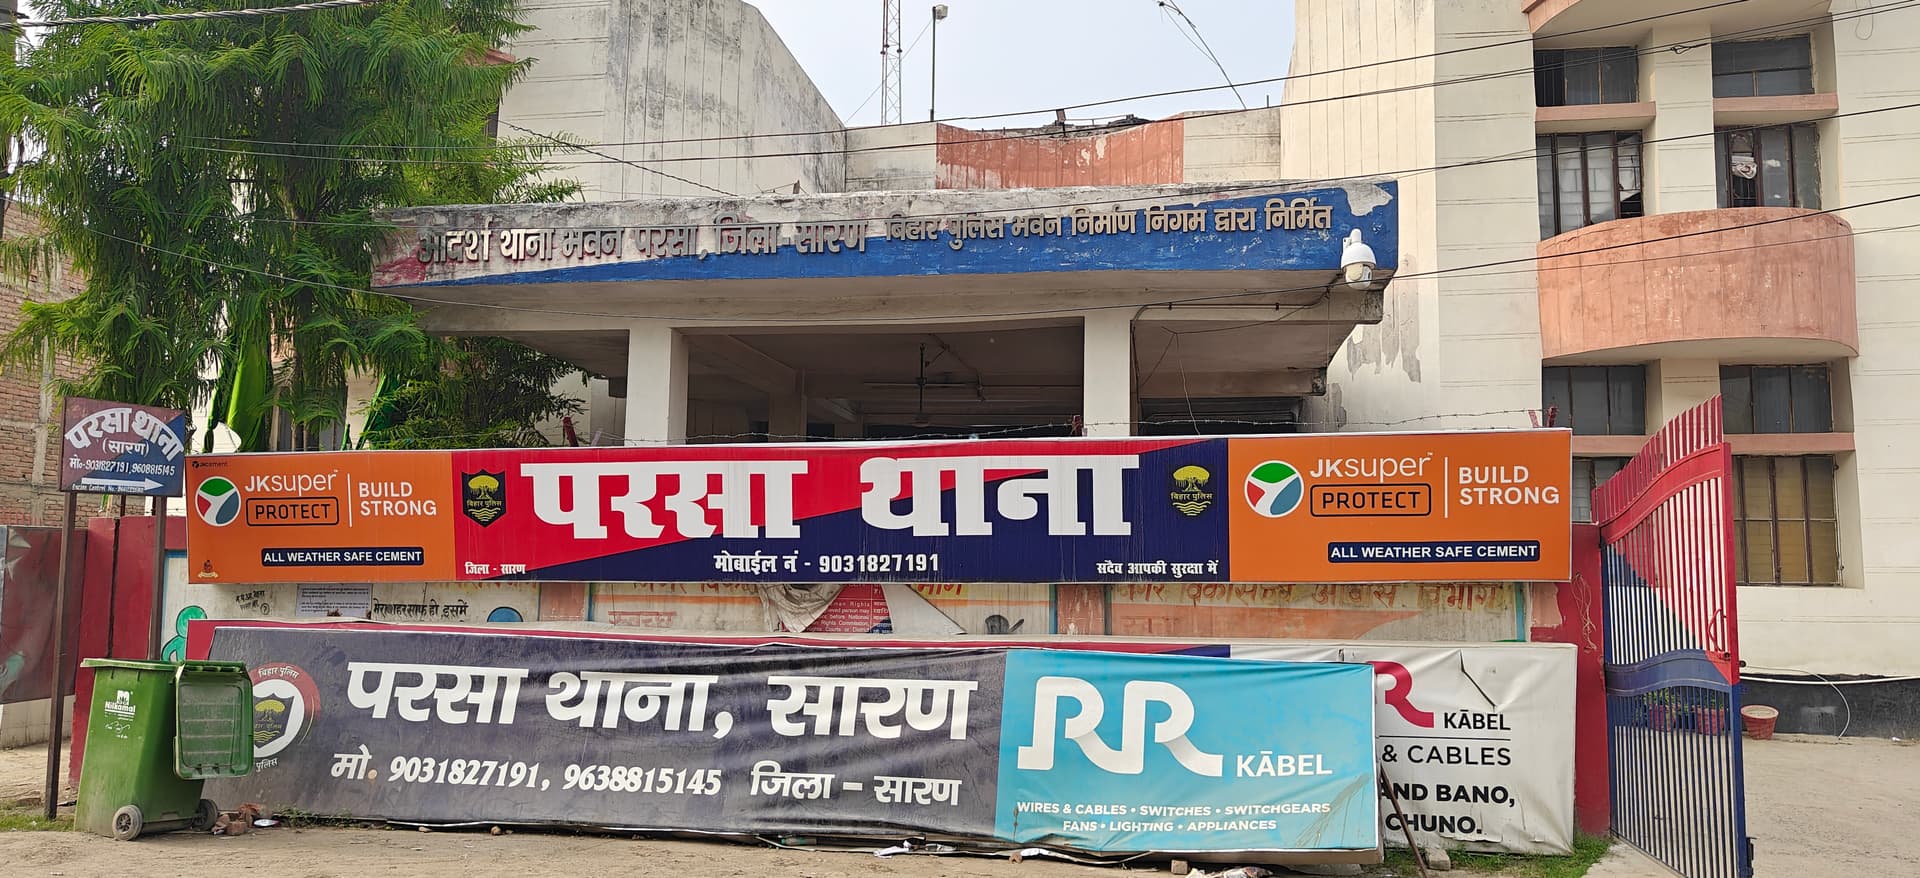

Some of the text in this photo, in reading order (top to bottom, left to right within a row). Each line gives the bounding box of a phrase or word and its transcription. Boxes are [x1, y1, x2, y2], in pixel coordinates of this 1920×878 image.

[885, 197, 1334, 251] बिहार पुलिस भवन निर्माण निगम द्वारा निर्मित
[419, 215, 492, 263] आदर्श
[499, 228, 558, 261] थाना
[562, 227, 624, 258] भवन
[64, 407, 185, 461] परसा थाना
[102, 437, 150, 457] (सारण)
[1458, 465, 1529, 485] BUILD
[358, 481, 413, 498] BUILD
[520, 453, 1140, 540] परसा थाना
[1170, 492, 1213, 501] बिहार पुलिस
[1322, 490, 1421, 509] PROTECT
[1459, 486, 1560, 506] STRONG
[254, 503, 331, 520] PROTECT
[359, 500, 438, 517] STRONG
[263, 550, 422, 563] ALL WEATHER SAFE CEMENT
[1330, 545, 1538, 559] ALL WEATHER SAFE CEMENT
[464, 561, 489, 575] जिला
[500, 563, 526, 575] सारण
[713, 550, 777, 575] मोबाईल
[783, 550, 799, 573] नं
[819, 553, 938, 574] 9031827191
[1096, 559, 1218, 578] सदैव आपकी सुरक्षा में
[258, 665, 300, 679] बिहार पुलिस
[347, 661, 529, 725] परसा
[766, 675, 979, 741] सारण
[1017, 675, 1224, 778] RR
[1443, 709, 1511, 731] KĀBEL
[1235, 750, 1334, 778] KĀBEL
[1382, 744, 1512, 766] & CABLES
[256, 759, 278, 772] पुलिस
[562, 763, 722, 795] 9638815145
[750, 760, 835, 800] जिला
[873, 775, 963, 806] सारण
[1436, 783, 1515, 808] BANO,
[1016, 801, 1331, 817] WIRES & CABLES SWITCHES SWITCHGEARS
[1062, 820, 1277, 833] FANS LIGHTING APPLIANCES
[1385, 812, 1483, 835] CHUNO.
